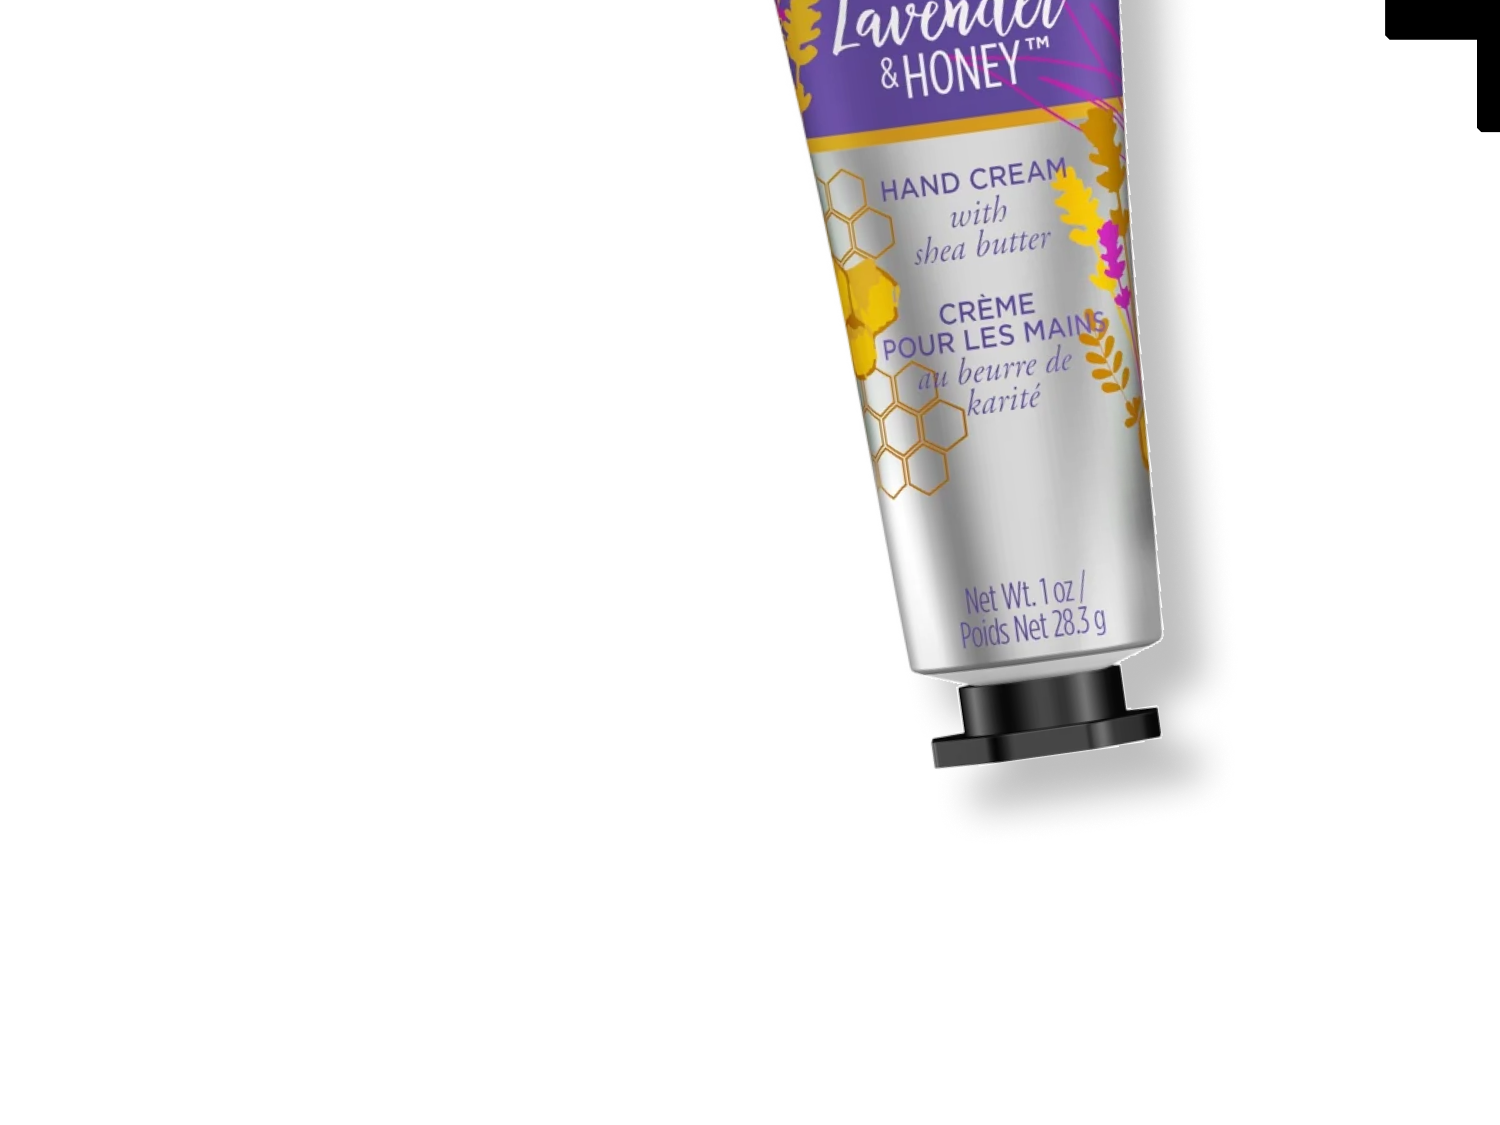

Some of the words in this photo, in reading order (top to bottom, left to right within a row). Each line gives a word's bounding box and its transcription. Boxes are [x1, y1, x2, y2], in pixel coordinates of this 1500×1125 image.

[880, 62, 900, 89] &
[880, 172, 960, 202] HAND
[969, 157, 1067, 192] CREAM
[950, 195, 1008, 228] with
[914, 236, 965, 266] shea
[976, 225, 1051, 257] butter
[939, 292, 1035, 325] CRÈME
[883, 331, 955, 361] POUR
[964, 324, 1014, 352] LES
[1025, 311, 1106, 342] MAINS
[918, 370, 950, 391] au
[958, 357, 1036, 385] beurre
[1046, 345, 1073, 373] de
[967, 383, 1041, 416] karité
[965, 585, 998, 615] Net
[1001, 581, 1036, 609] Wt.
[1040, 578, 1049, 605] 1
[1054, 579, 1074, 604] oz
[1079, 569, 1086, 603] /
[960, 618, 1010, 649] Poids
[1014, 613, 1048, 643] Net
[1051, 605, 1091, 637] 28.3
[1094, 609, 1107, 636] g
